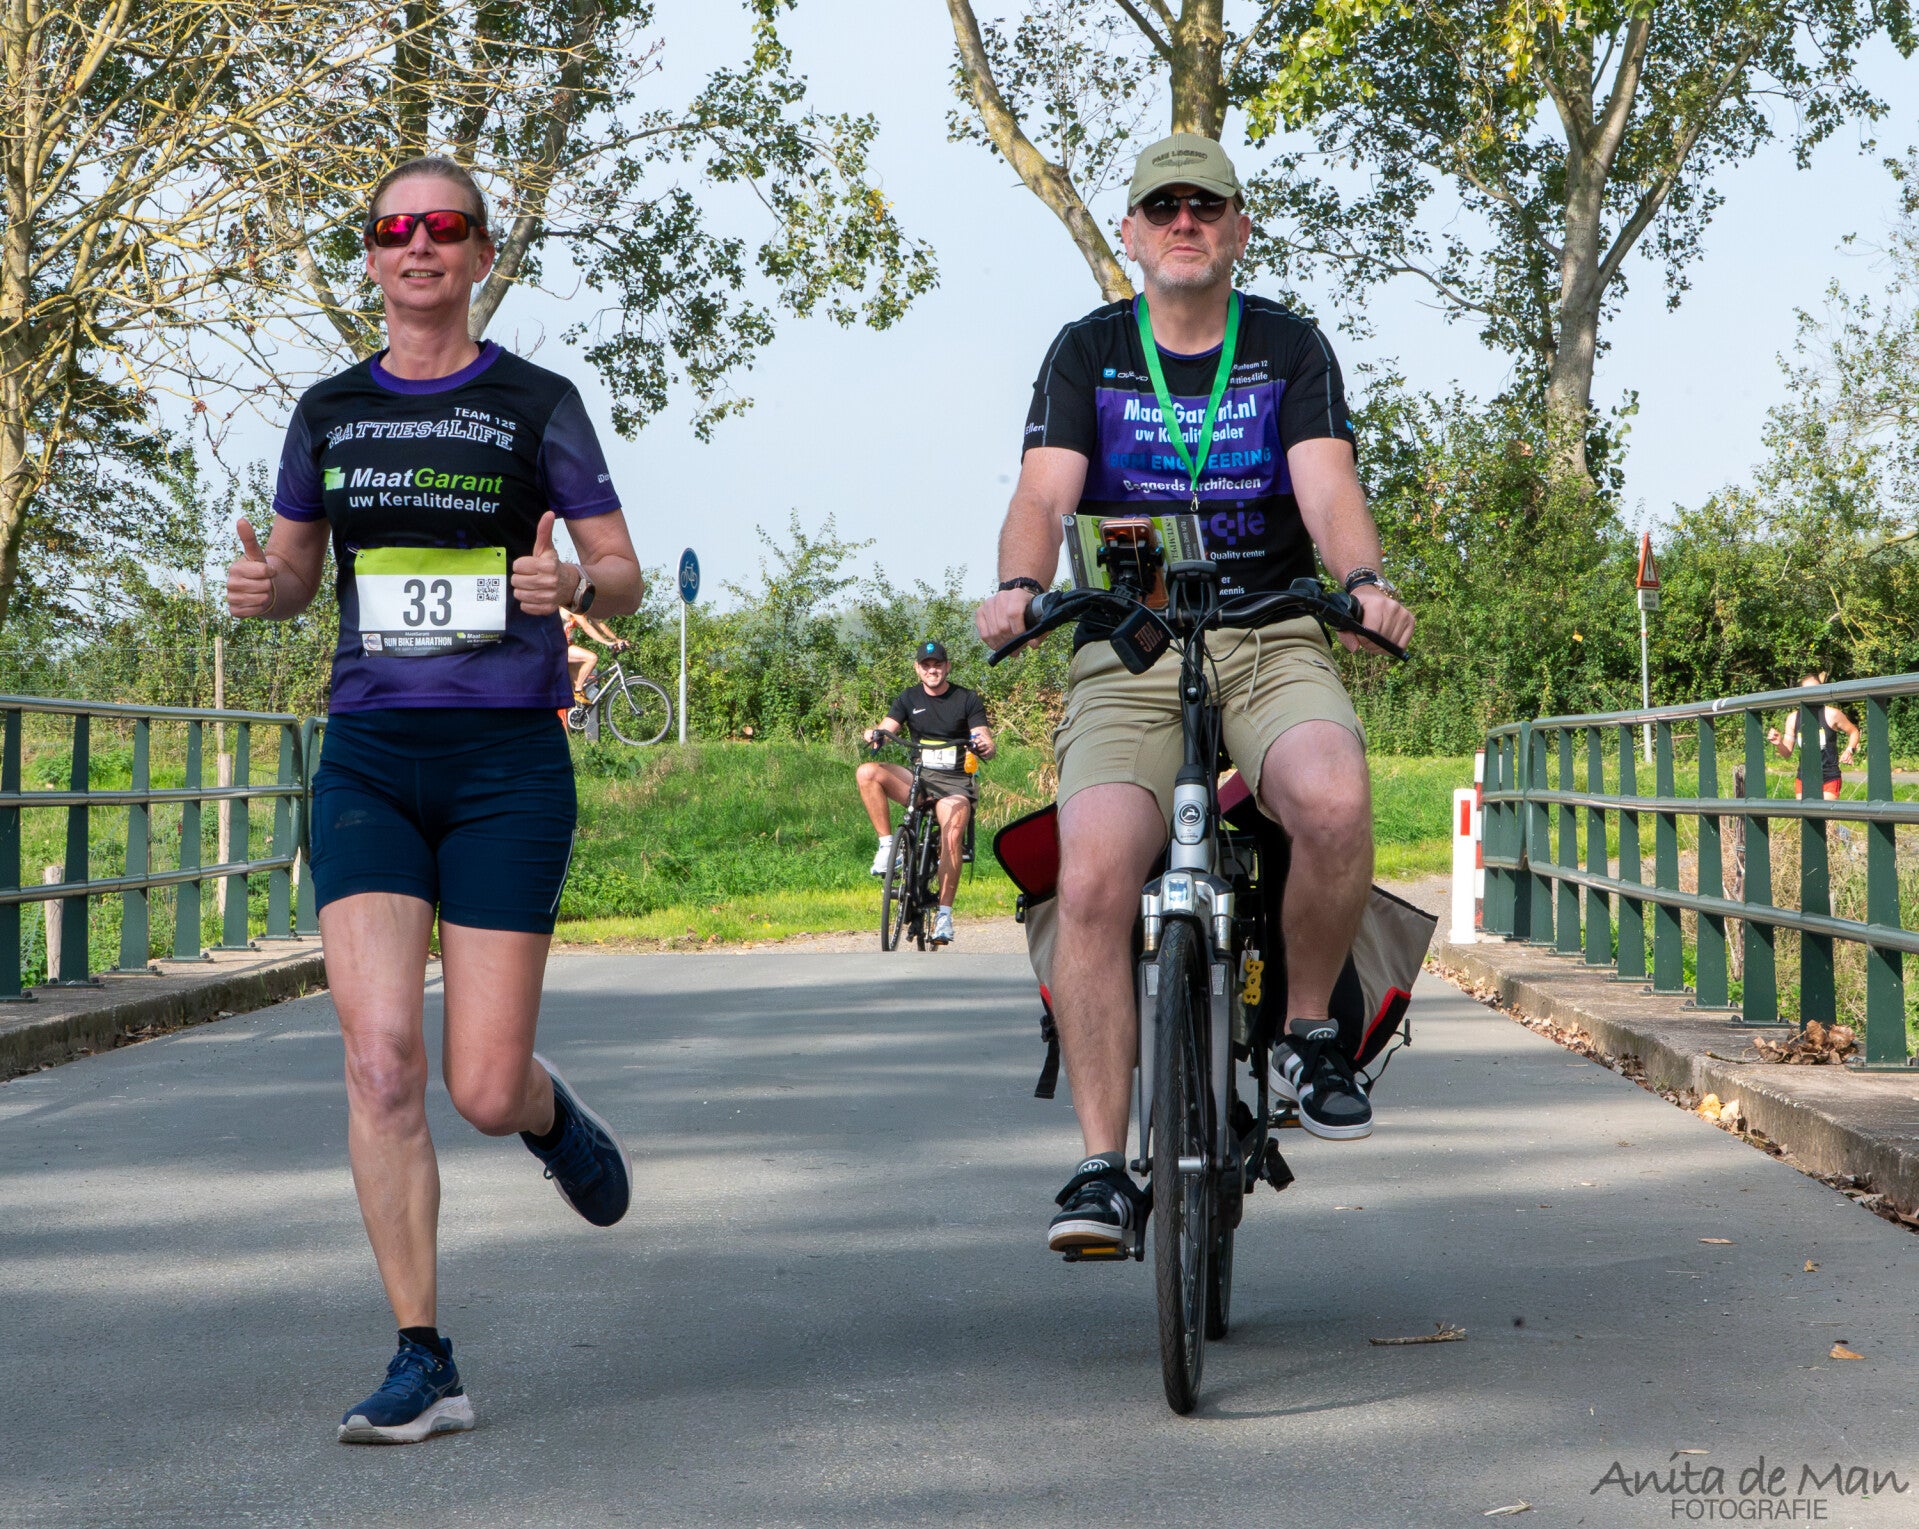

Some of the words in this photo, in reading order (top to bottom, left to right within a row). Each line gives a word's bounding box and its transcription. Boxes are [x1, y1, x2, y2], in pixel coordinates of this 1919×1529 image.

[454, 406, 491, 422] TEAM
[494, 416, 517, 431] 125
[1123, 393, 1257, 424] MaaGarnt.nl
[326, 420, 514, 451] MATTIES4LIFE
[1135, 429, 1155, 441] uw
[1158, 423, 1245, 443] Kalitealer
[1151, 447, 1272, 471] ENGEERING
[349, 467, 503, 494] MaatGarant
[349, 495, 375, 508] uw
[379, 492, 501, 514] Keralitdealer
[1210, 550, 1241, 561] Quality
[402, 578, 453, 627] 33
[384, 637, 397, 647] RUN
[398, 637, 414, 647] BIKE
[415, 636, 453, 647] MARATHON
